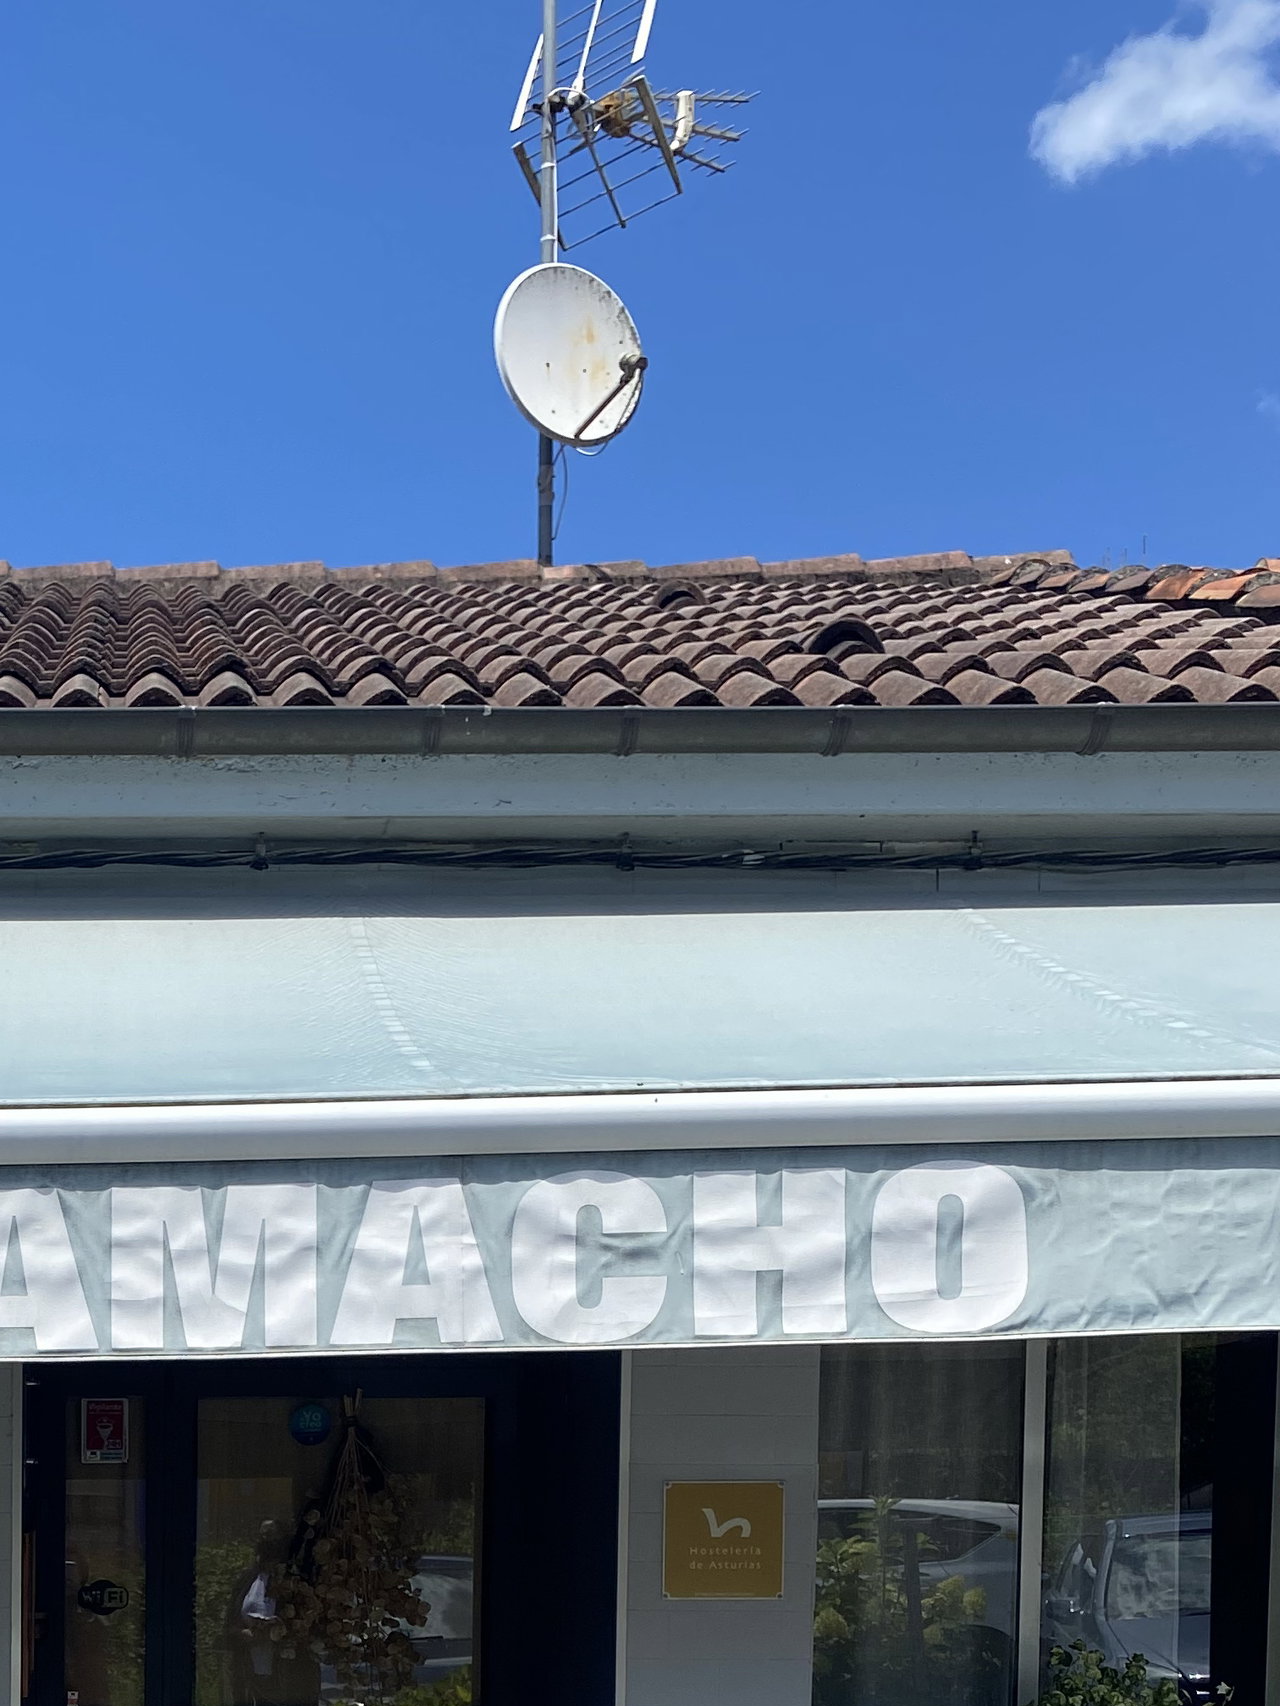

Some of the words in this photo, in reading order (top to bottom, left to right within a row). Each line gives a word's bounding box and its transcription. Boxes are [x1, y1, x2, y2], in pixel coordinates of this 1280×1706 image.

[689, 1546, 761, 1556] Hostelería
[689, 1560, 704, 1570] de
[708, 1560, 761, 1570] Asturias
